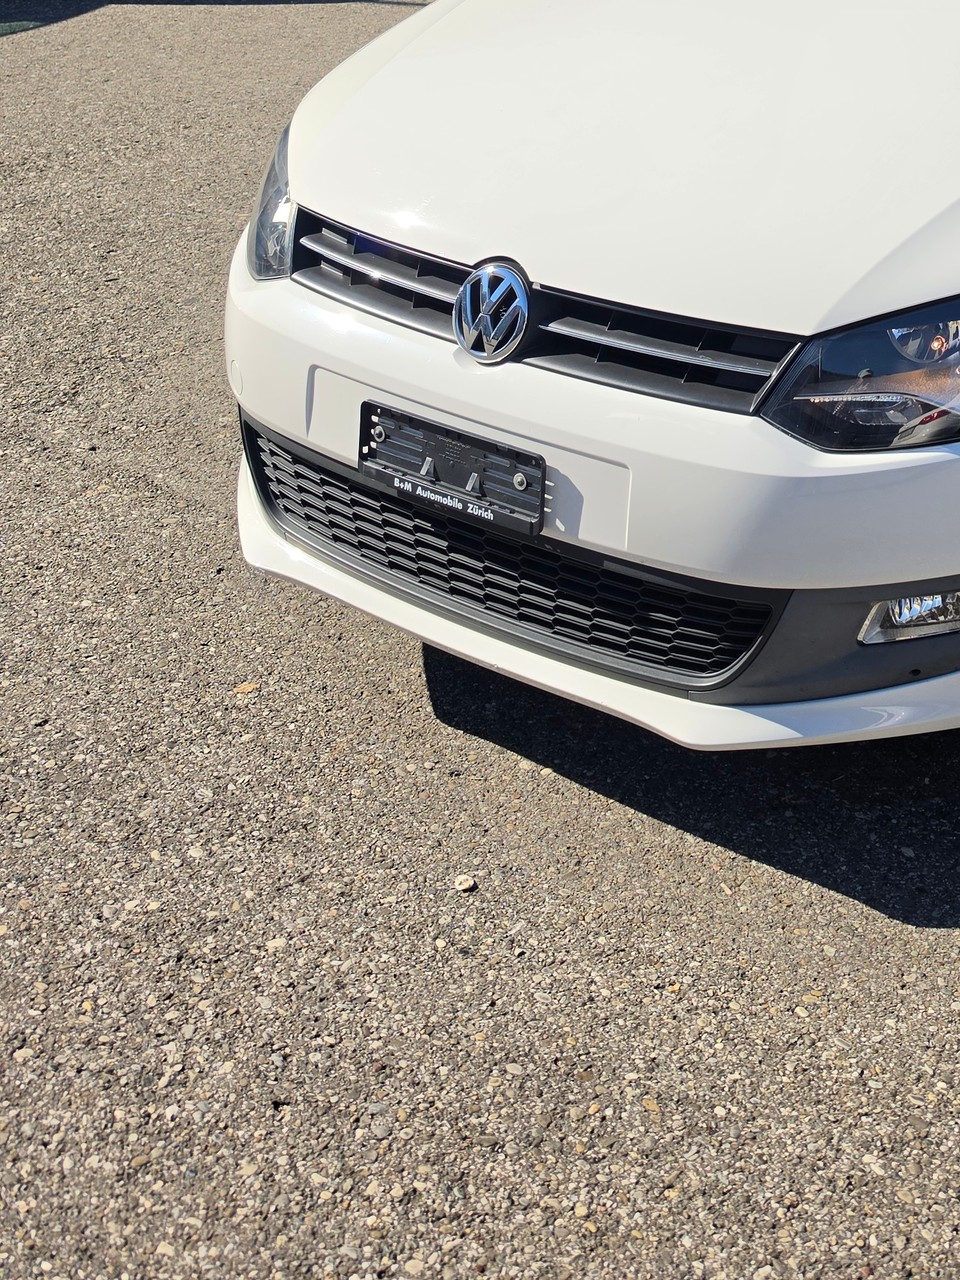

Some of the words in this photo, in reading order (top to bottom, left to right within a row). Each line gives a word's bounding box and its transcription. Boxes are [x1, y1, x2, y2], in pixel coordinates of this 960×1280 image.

[393, 477, 413, 493] B+M
[416, 484, 463, 510] Automobile
[467, 503, 494, 521] Zürich
